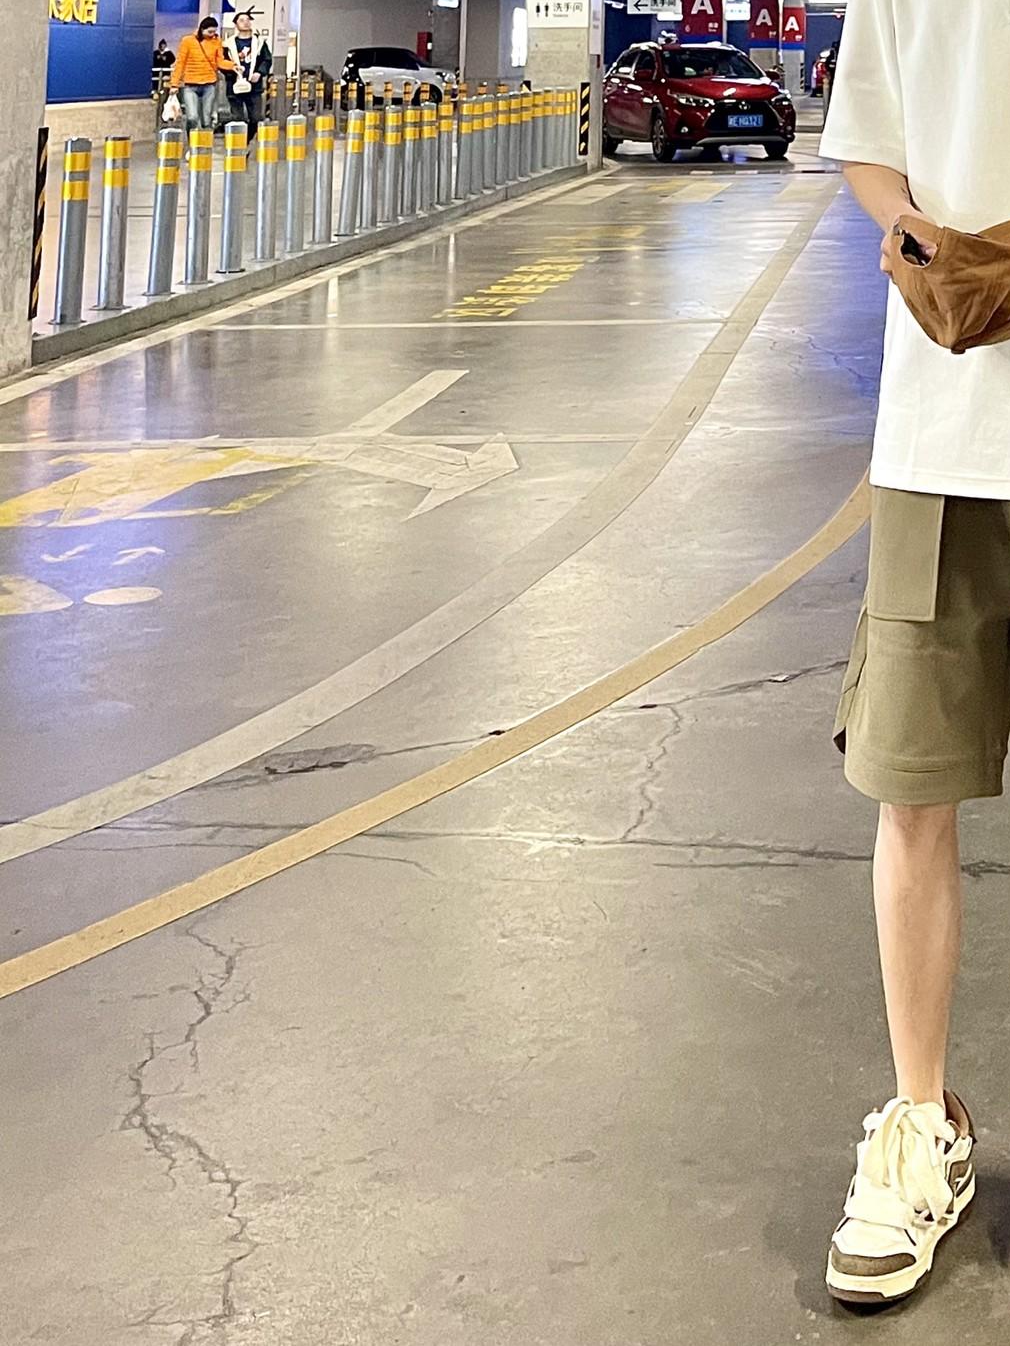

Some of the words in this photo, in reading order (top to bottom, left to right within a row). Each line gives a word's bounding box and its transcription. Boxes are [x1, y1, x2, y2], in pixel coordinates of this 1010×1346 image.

[553, 2, 583, 12] 洗手间
[755, 8, 773, 25] A
[784, 16, 800, 31] A
